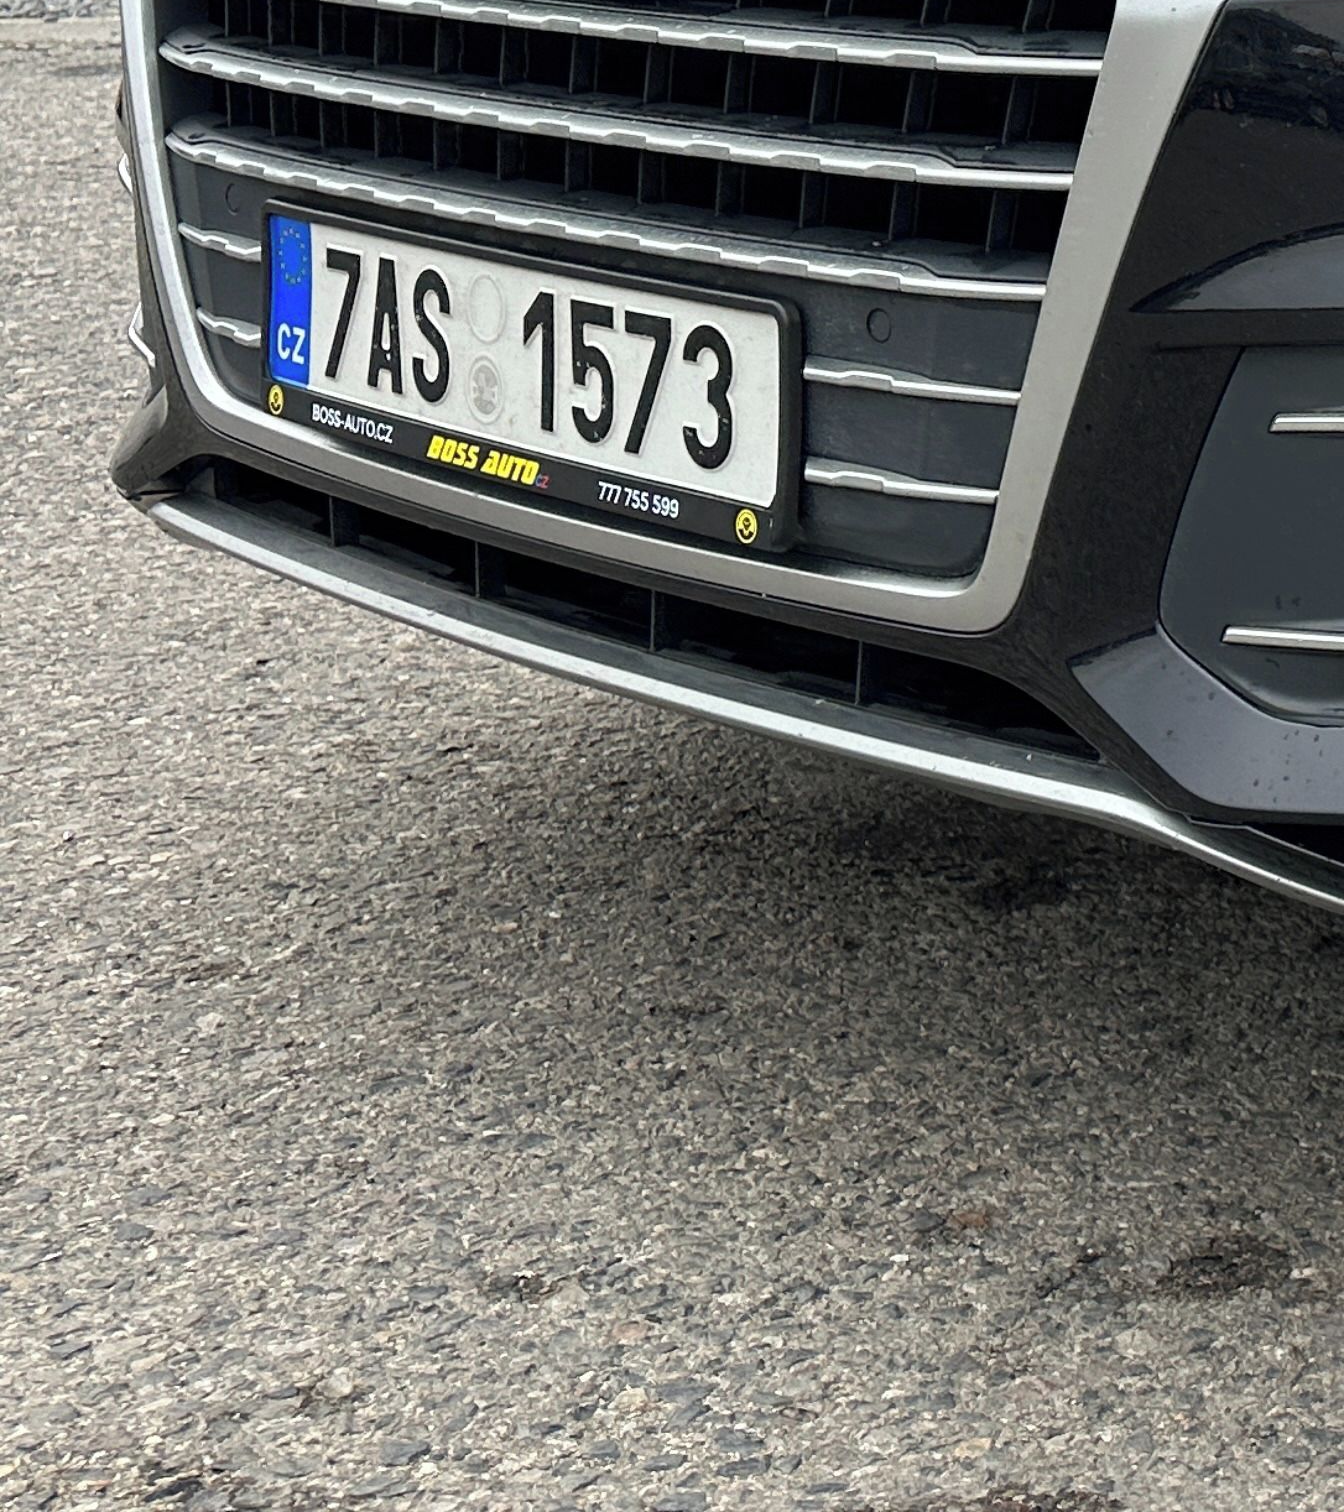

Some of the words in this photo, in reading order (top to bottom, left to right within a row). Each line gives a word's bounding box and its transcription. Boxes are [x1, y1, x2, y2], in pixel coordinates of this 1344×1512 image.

[277, 322, 306, 365] CZ
[325, 247, 452, 405] 7AS
[522, 290, 735, 472] 1573
[312, 403, 394, 444] BOSS-AUTO.CZ
[426, 434, 480, 469] BOSS
[598, 480, 622, 504] 777
[624, 489, 650, 513] 755
[651, 495, 680, 519] 599
